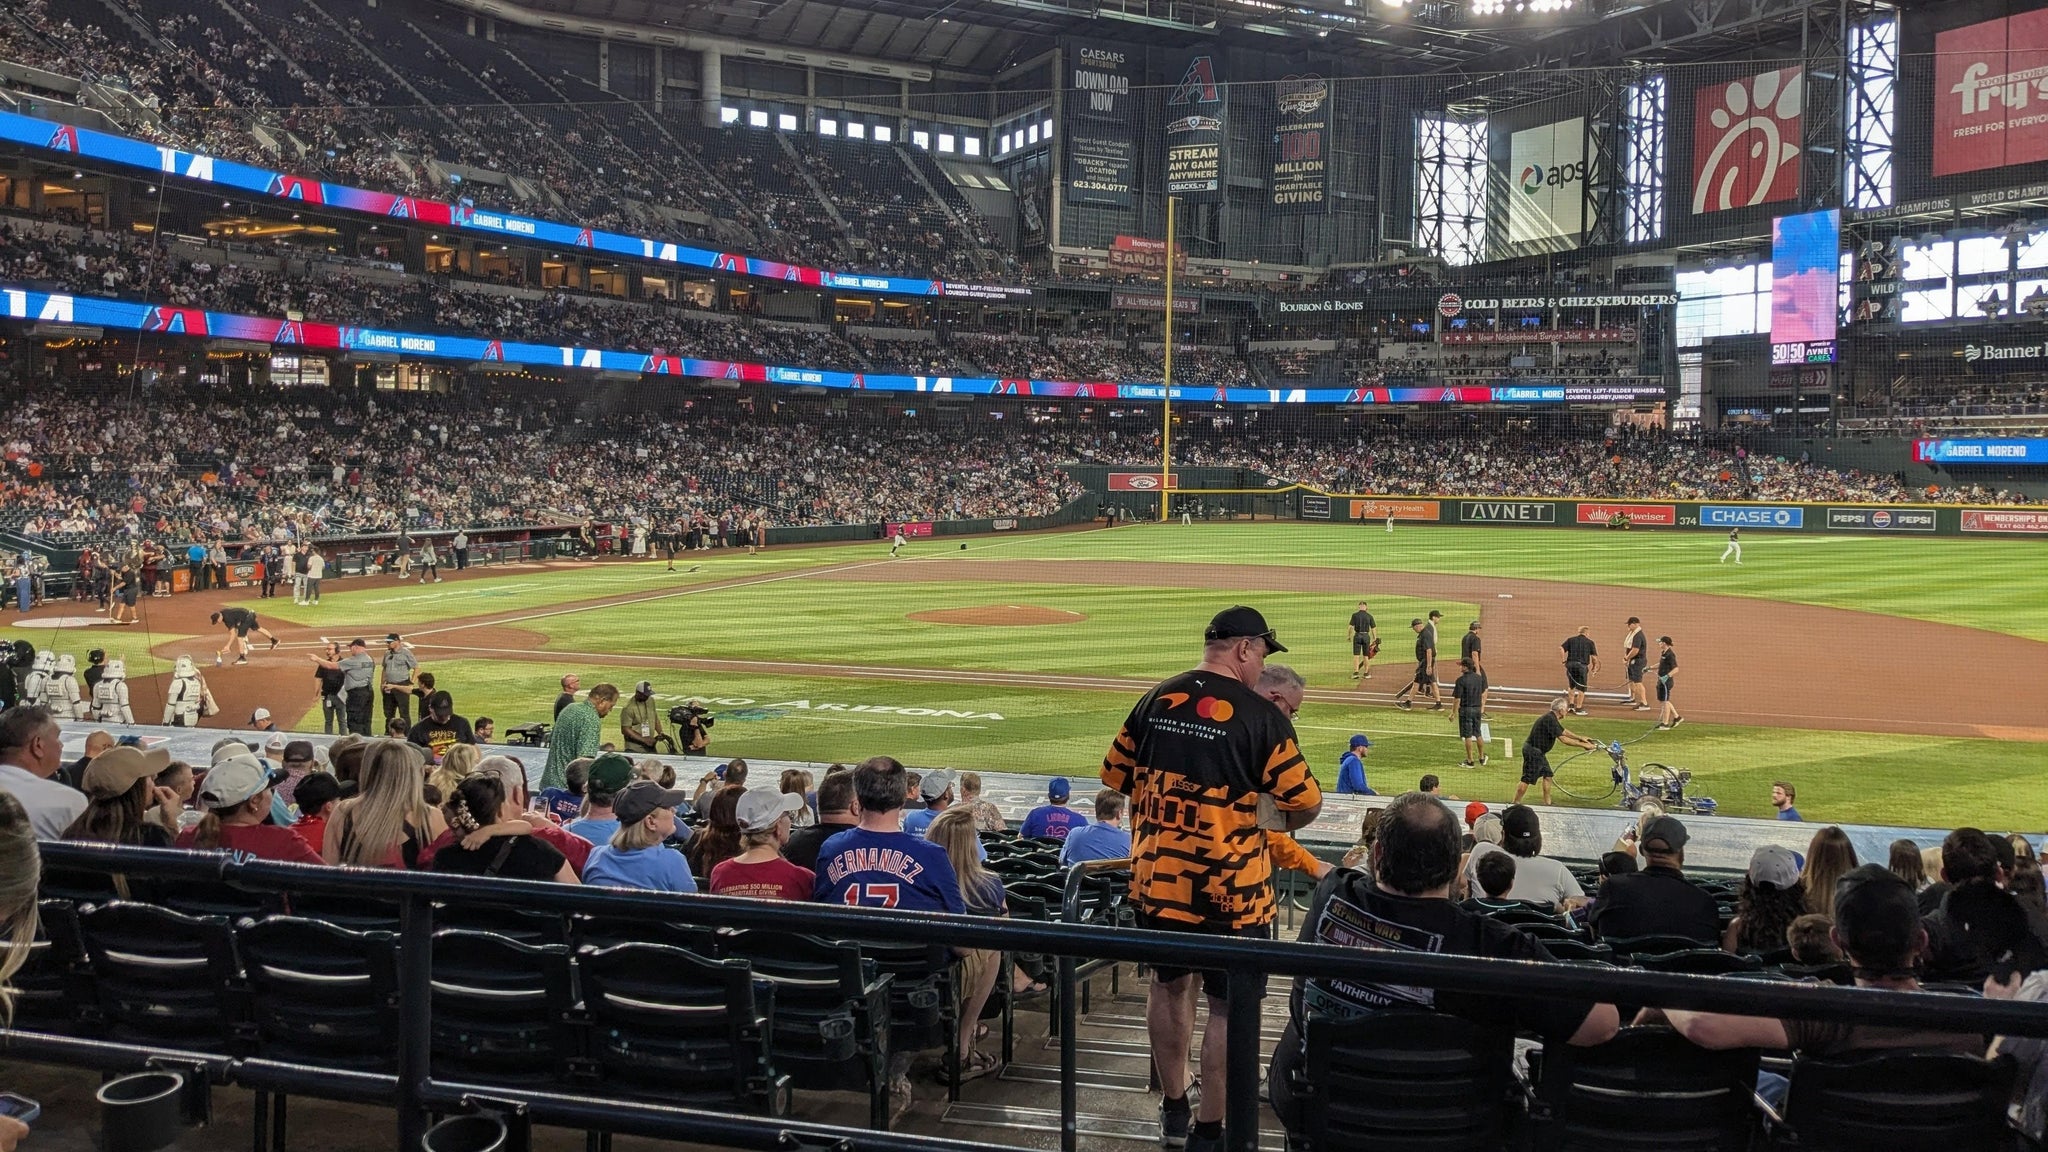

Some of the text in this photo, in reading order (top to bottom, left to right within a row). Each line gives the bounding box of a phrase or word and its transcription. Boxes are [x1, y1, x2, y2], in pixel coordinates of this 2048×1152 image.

[1080, 48, 1125, 63] CAESARS
[1076, 70, 1129, 95] DOWNLOAD
[1091, 91, 1114, 112] NOW
[1276, 122, 1325, 131] CELEBRATING
[1953, 125, 1982, 138] FRESH
[1985, 122, 2005, 132] FOR
[1169, 148, 1218, 160] STREAM
[1086, 166, 1117, 175] LOCATION
[1169, 160, 1218, 171] ANY GAME
[1274, 161, 1323, 173] MILLION
[1169, 170, 1218, 180] ANYWHERE
[1294, 173, 1303, 181] IN
[1547, 161, 1584, 189] aps
[1073, 180, 1128, 192] 623.304.0777
[1275, 182, 1322, 191] CHARITABLE
[1275, 190, 1323, 204] GIVING
[1971, 185, 2048, 205] WORLD CHAMPI
[1853, 199, 1950, 221] NL WEST CHAMPIONS
[473, 214, 504, 229] GABRIEL
[506, 219, 535, 234] MORENO
[1131, 239, 1165, 249] Honeywell
[1113, 252, 1186, 268] SANDLT
[834, 276, 861, 287] GABRIEL
[862, 278, 889, 289] MORENO
[1871, 283, 1894, 295] WILD
[1324, 300, 1333, 311] &
[1465, 299, 1499, 309] COLD
[1502, 297, 1545, 308] BEERS
[1548, 298, 1556, 307] &
[1559, 294, 1677, 307] CHEESEBURGERS
[364, 333, 399, 349] GABRIEL
[401, 339, 435, 352] MORENO
[1539, 332, 1562, 342] Burger
[1564, 331, 1581, 339] Joint
[1808, 354, 1831, 362] CARES
[1983, 345, 2041, 360] Banner
[780, 373, 801, 382] GABRIEL
[802, 374, 822, 383] MORENO
[1134, 387, 1157, 397] GABRIEL
[1158, 388, 1181, 397] MOENO
[1511, 390, 1540, 399] GABRIEL
[1946, 445, 1984, 457] GABRIEL
[1987, 445, 2027, 457] MORENO
[1471, 504, 1544, 519] AVNET
[1712, 511, 1772, 523] CHASE
[1679, 517, 1697, 526] 374
[1833, 515, 1865, 523] PEPSI
[1898, 516, 1931, 524] PEPSI
[1984, 514, 2036, 523] MEMBERSHIPS
[764, 699, 1005, 720] ARIZONA
[1155, 725, 1215, 740] FORMULA TEAM
[1180, 722, 1227, 736] MASTERCARD
[827, 848, 924, 885] HERNANDEZ
[843, 883, 900, 909] 17
[1331, 903, 1402, 941] SEPARATE WAYS
[1333, 928, 1355, 946] DON'T
[1330, 979, 1392, 1006] FAITHFULLY
